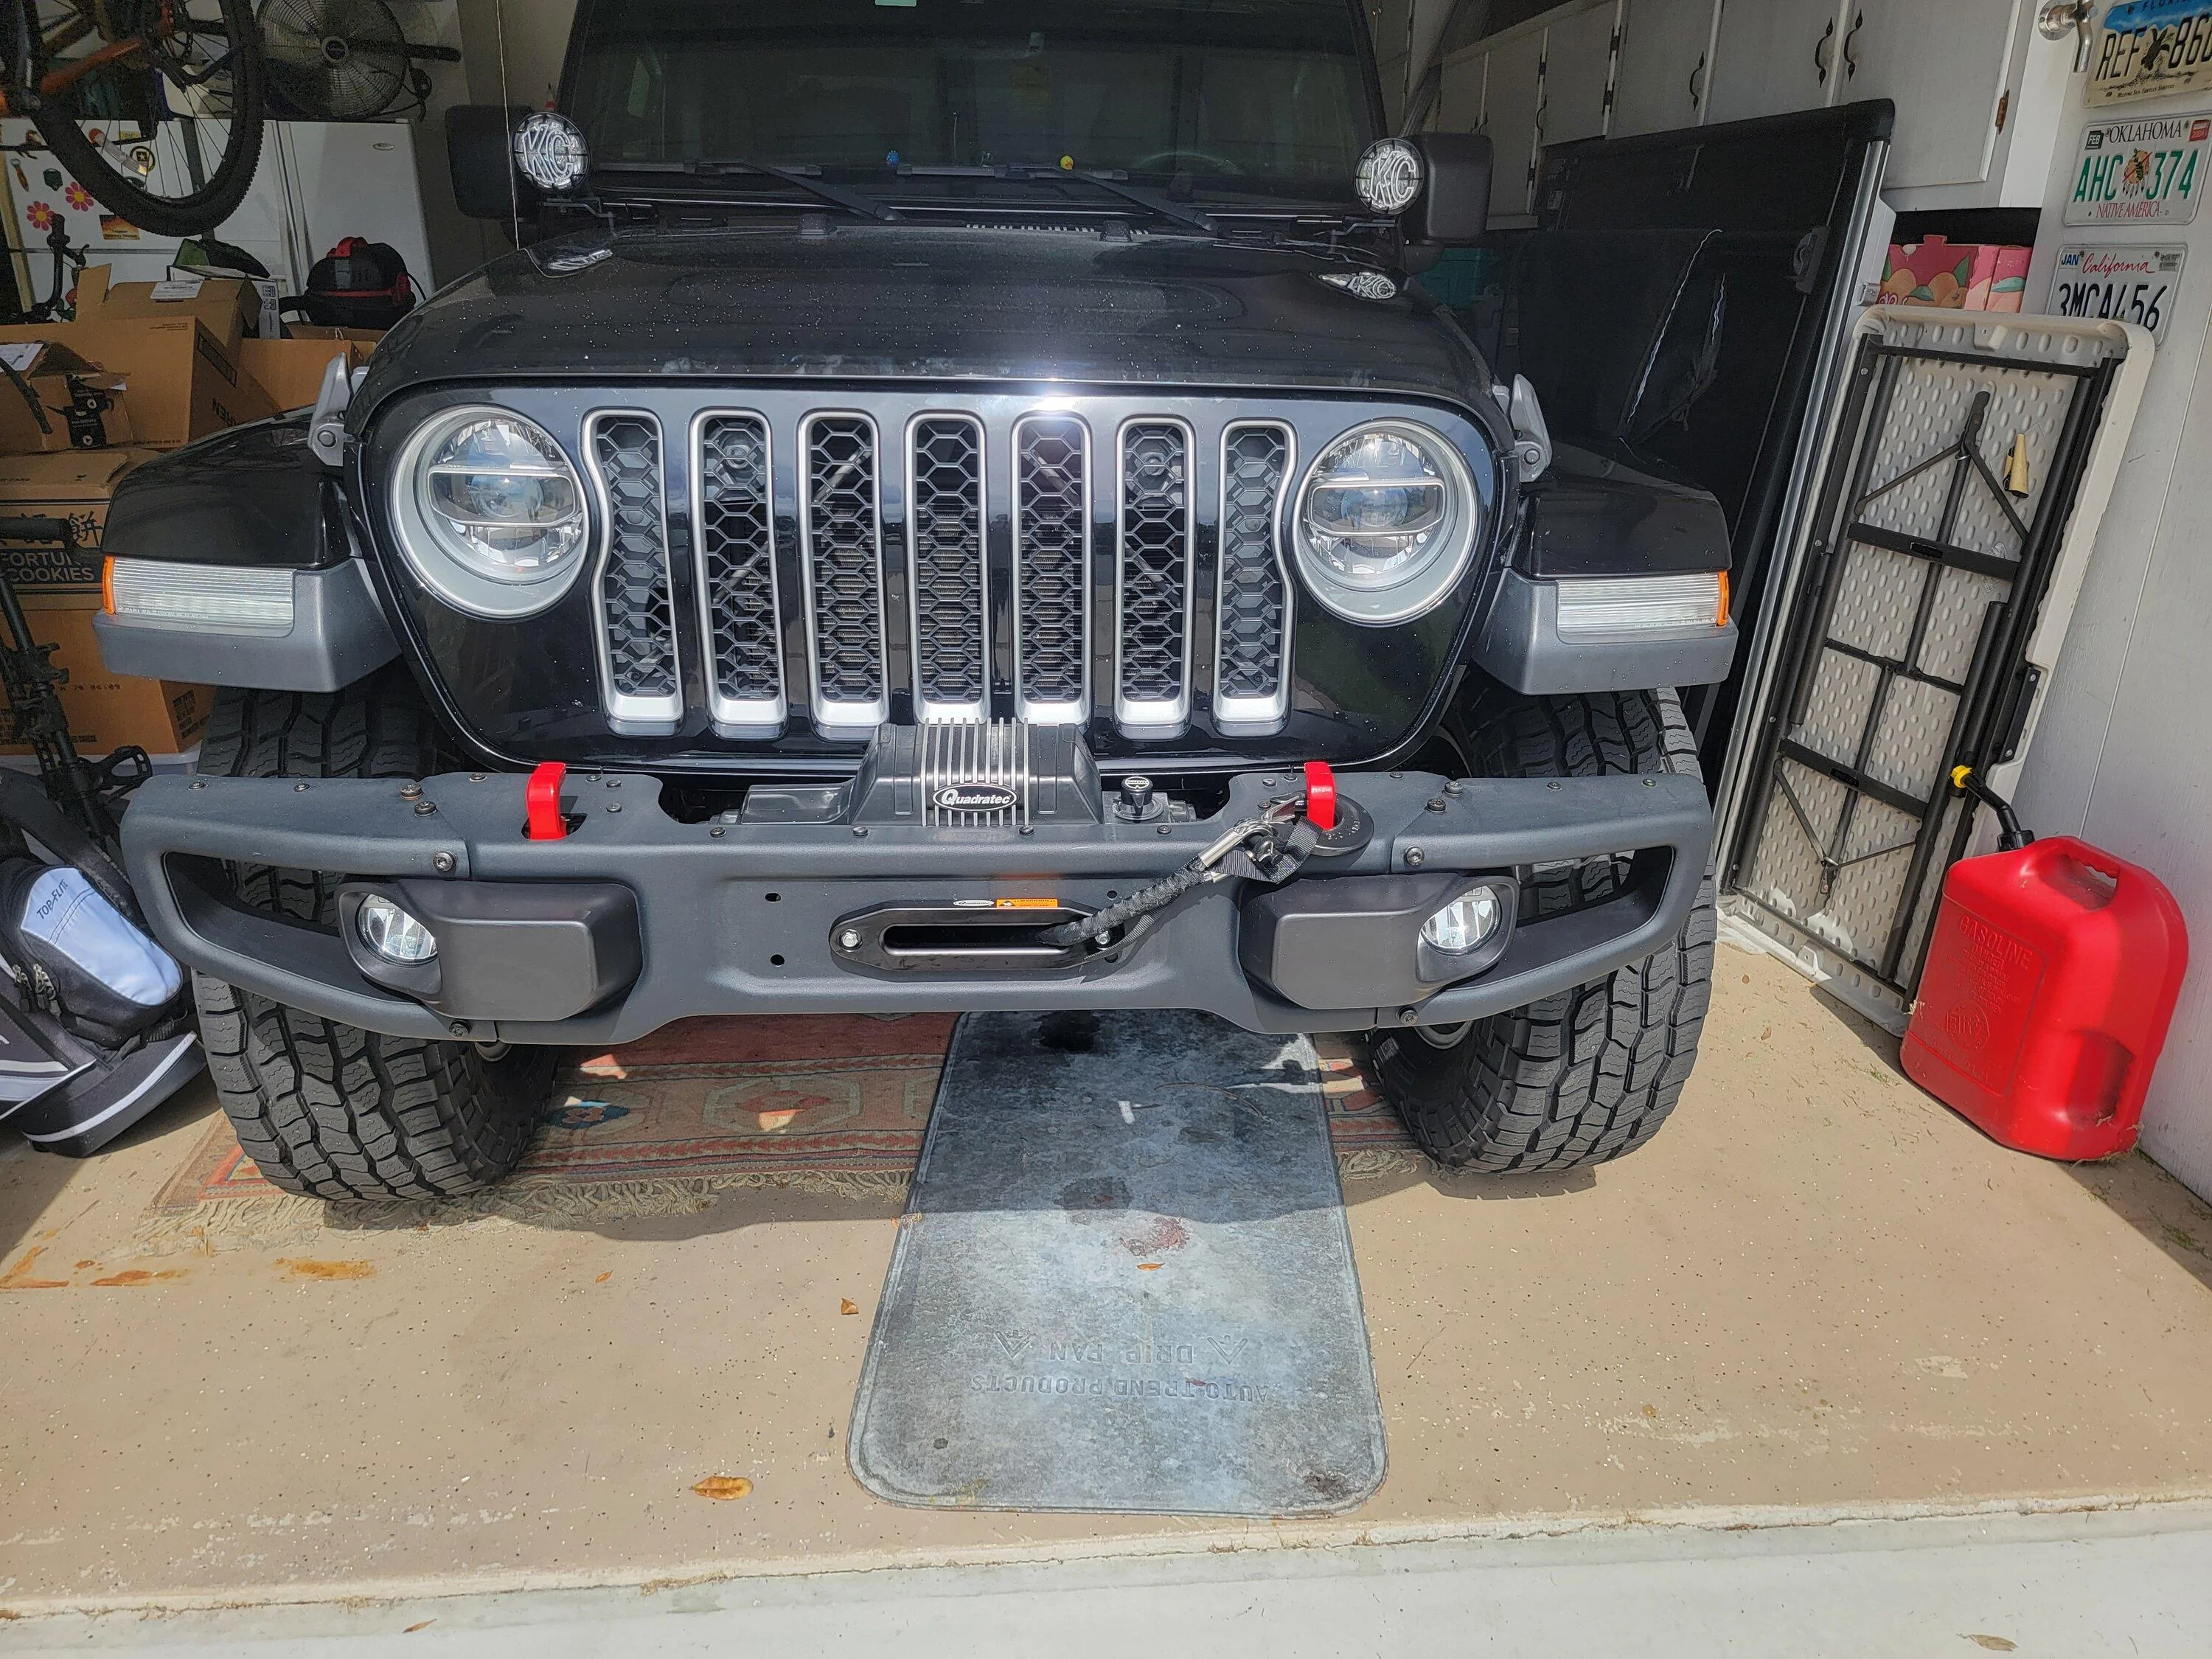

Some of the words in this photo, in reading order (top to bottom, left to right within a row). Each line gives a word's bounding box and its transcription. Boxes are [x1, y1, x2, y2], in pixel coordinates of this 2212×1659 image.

[2095, 27, 2147, 81] REF
[2088, 135, 2100, 145] FEB
[2109, 120, 2182, 143] OKLAHOMA
[521, 124, 574, 183] KC
[1369, 150, 1416, 208] KC
[2073, 153, 2124, 203] AHC
[2146, 149, 2199, 201] 374
[2096, 202, 2124, 219] NATIVE
[2124, 201, 2160, 218] AMERICA
[2061, 254, 2079, 266] JAN
[2082, 252, 2155, 279] California
[0, 552, 81, 567] FORTU
[6, 567, 95, 582] COOKIES
[942, 788, 1010, 805] Quadratec
[1960, 914, 2033, 970] GASOLINE
[1049, 1340, 1103, 1363] PAN
[1126, 1342, 1193, 1365] DRIP
[970, 1375, 1103, 1396] PRODUCTS
